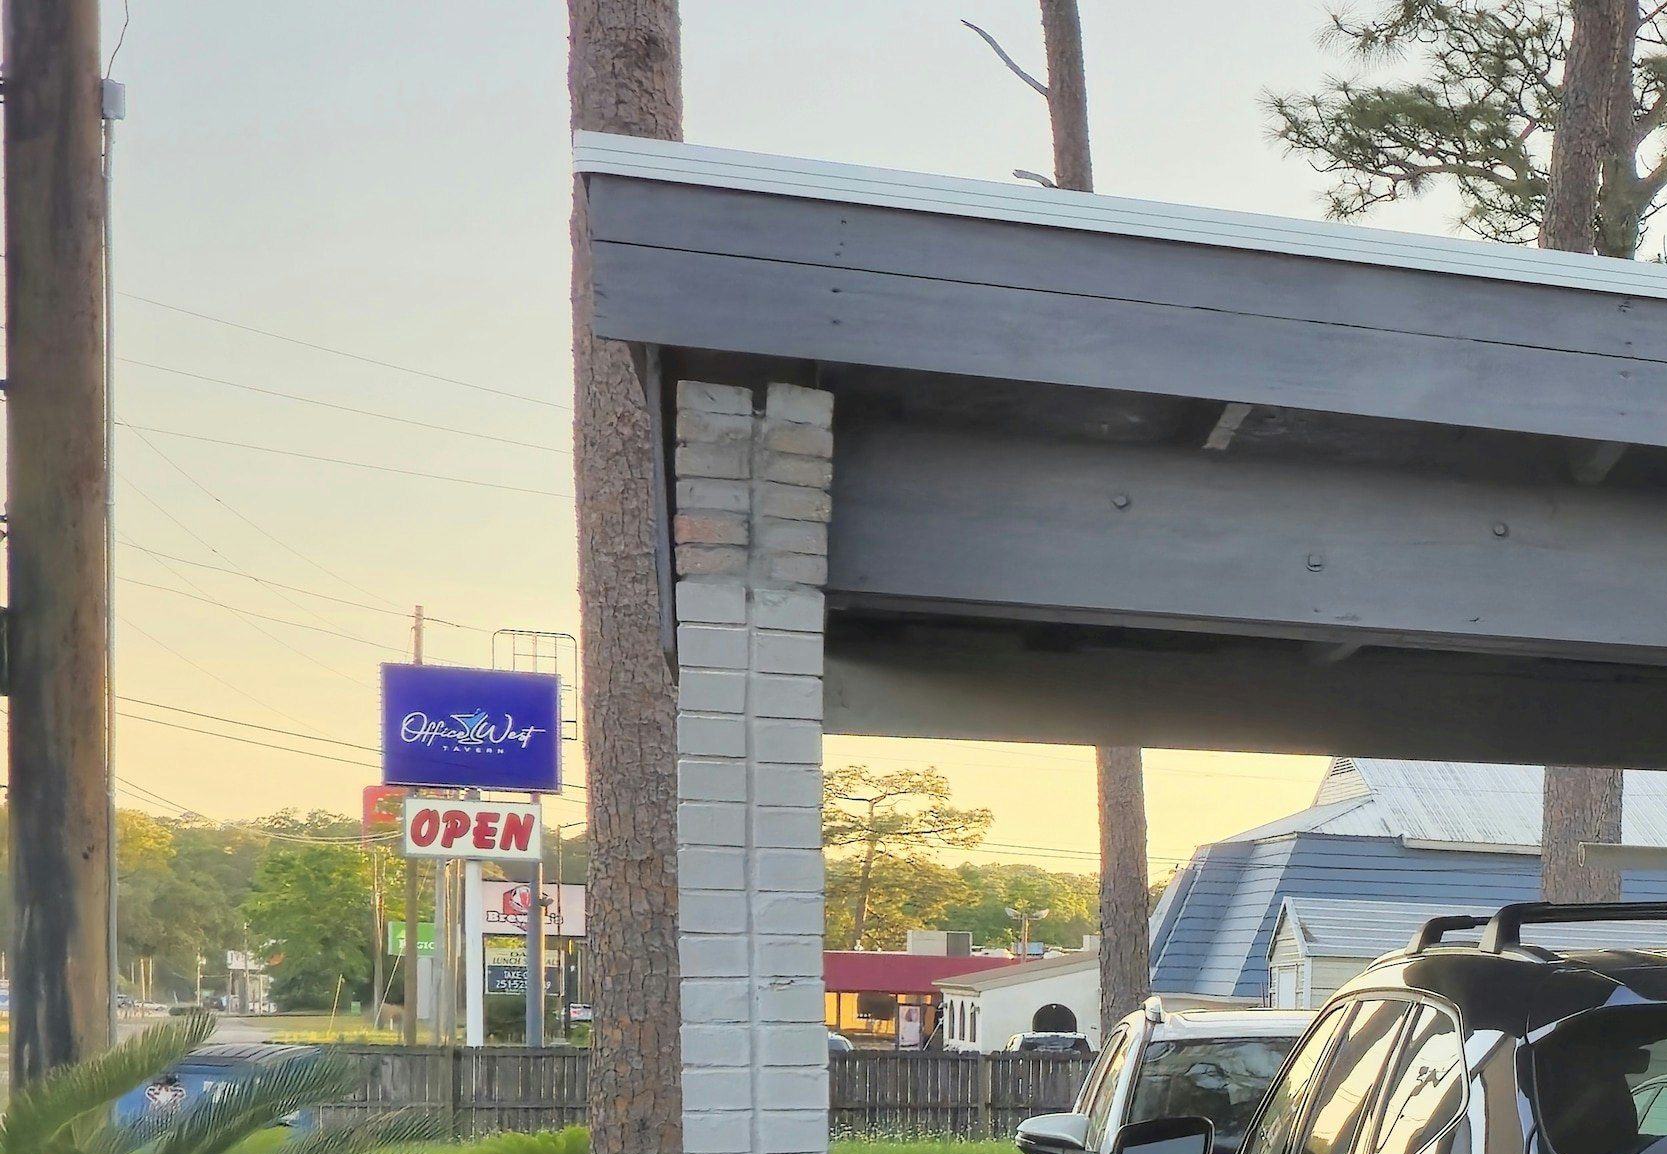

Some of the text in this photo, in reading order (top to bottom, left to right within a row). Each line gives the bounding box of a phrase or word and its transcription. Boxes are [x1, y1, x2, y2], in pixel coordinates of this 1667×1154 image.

[401, 711, 546, 748] Office West
[443, 745, 504, 754] TAVERN
[410, 808, 535, 851] OPEN
[492, 957, 521, 965] LUNCH
